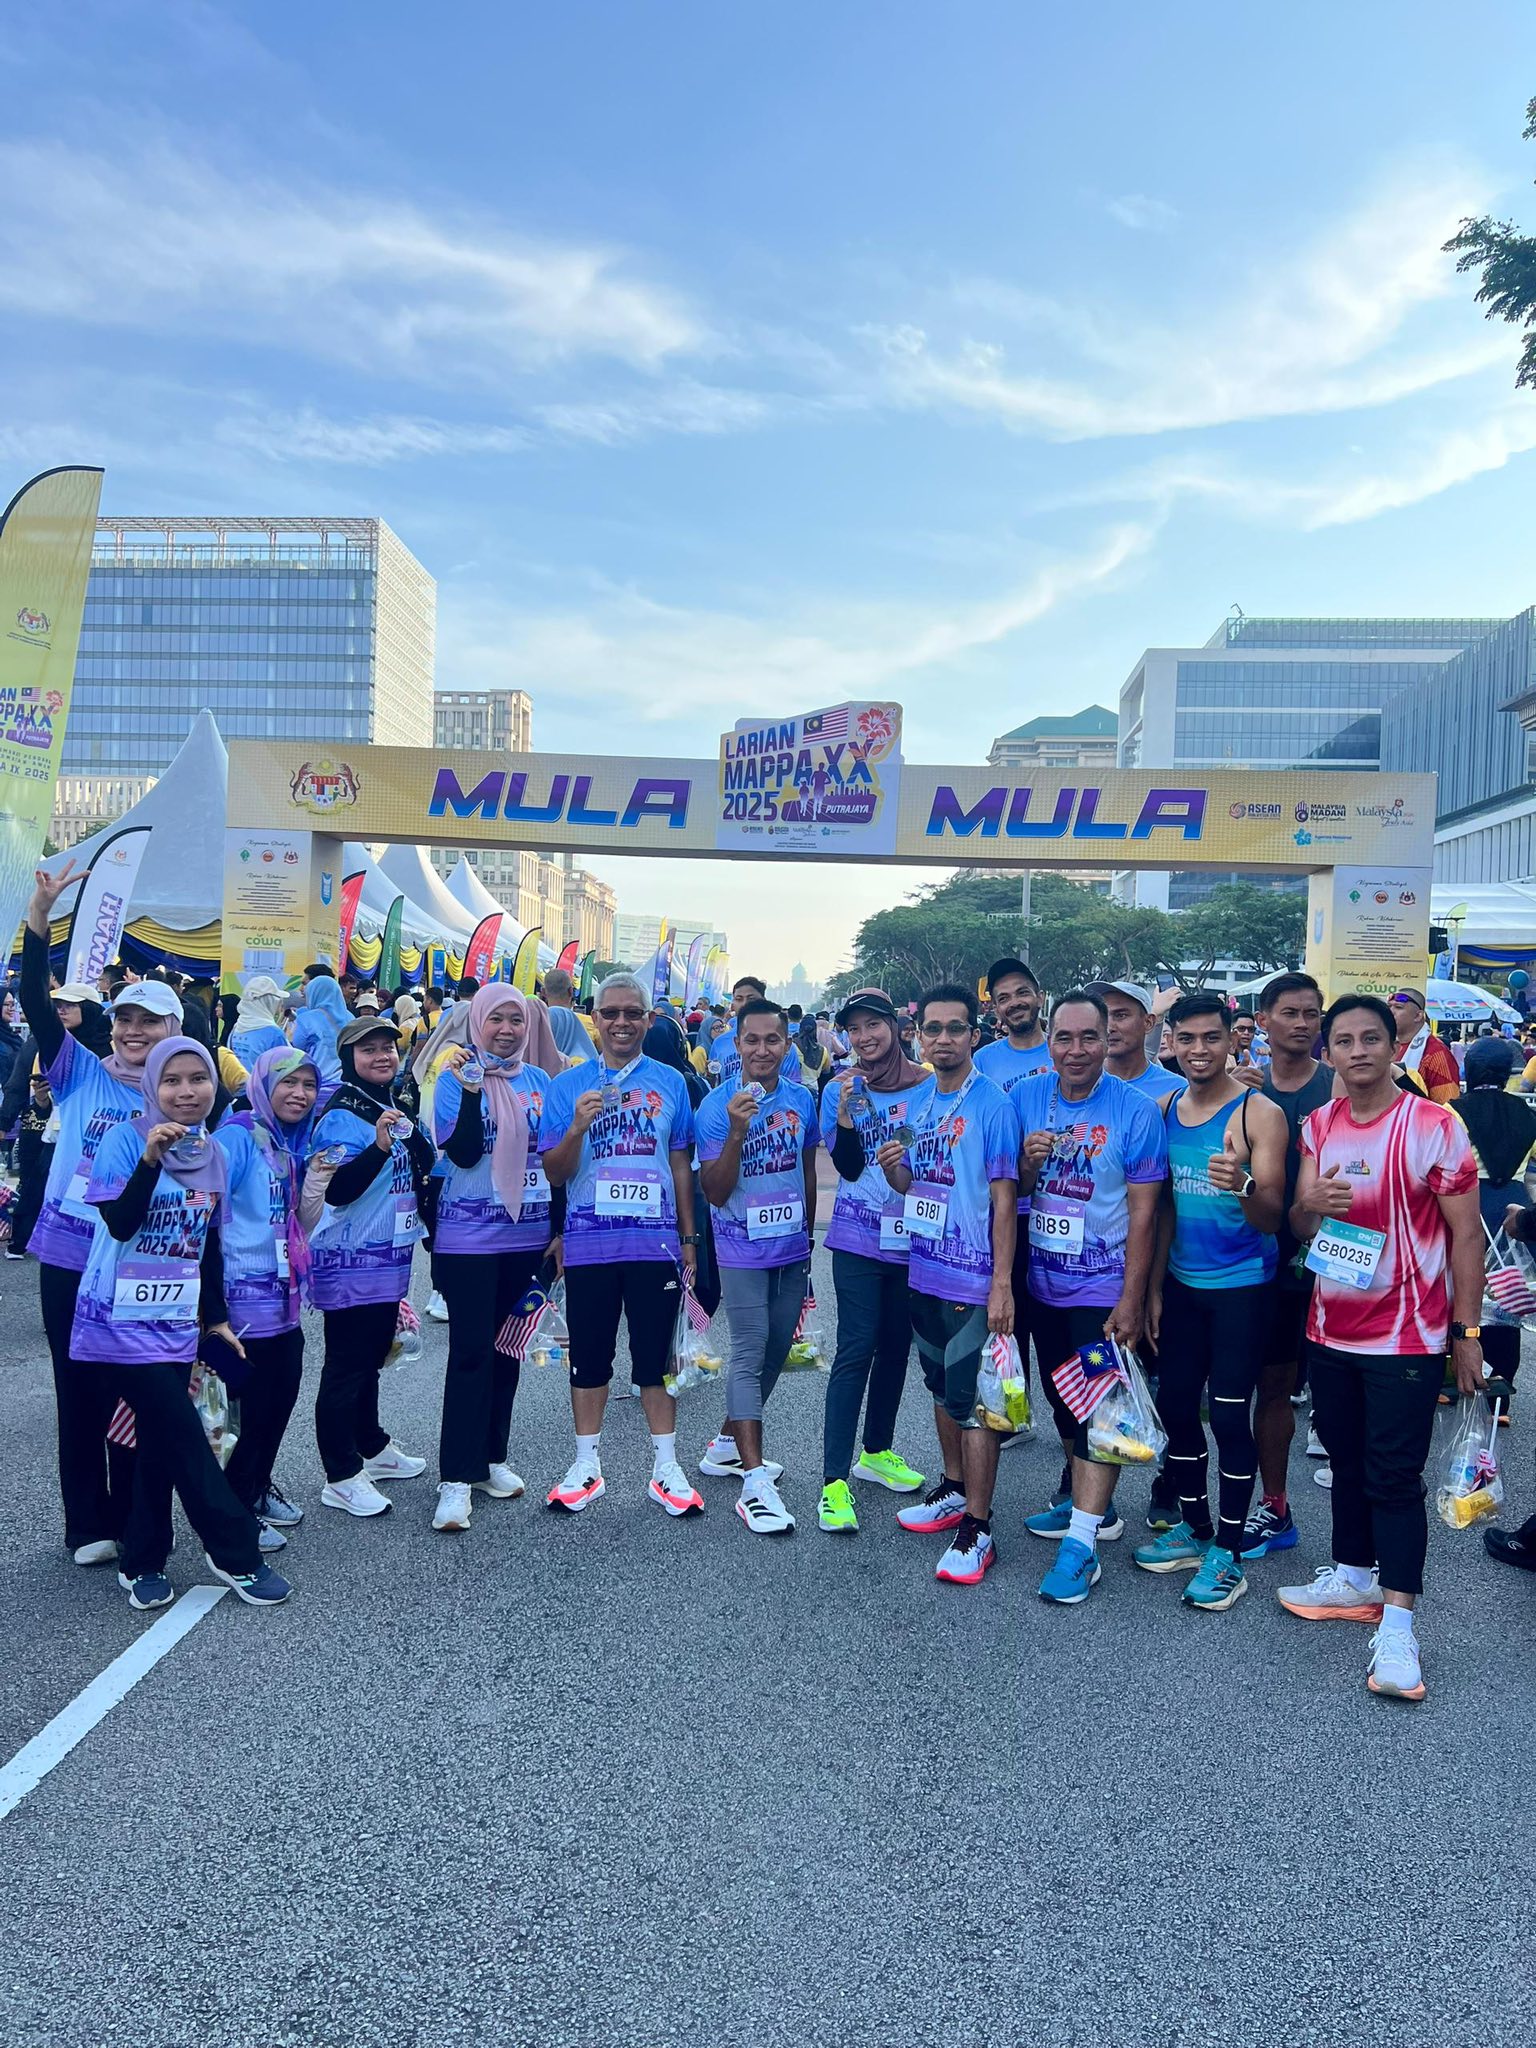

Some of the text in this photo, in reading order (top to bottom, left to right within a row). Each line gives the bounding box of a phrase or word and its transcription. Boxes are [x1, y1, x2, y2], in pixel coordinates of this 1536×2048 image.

[0, 687, 17, 701] AN
[725, 721, 796, 760] LARIAN
[24, 767, 49, 781] 2025
[724, 740, 874, 791] MAPPA XX
[428, 767, 693, 829] MULA
[723, 790, 781, 821] 2025
[1310, 803, 1346, 811] MALAYSIA
[825, 803, 869, 814] PUTRAJAYA
[925, 785, 1209, 840] MULA
[1248, 803, 1281, 814] ASEAN
[1310, 809, 1346, 817] MADANI
[743, 1122, 766, 1144] ARIAN
[742, 1158, 765, 1178] 2025
[609, 1184, 649, 1201] 6178
[1173, 1178, 1220, 1197] RATHON
[149, 1191, 183, 1211] ARIAN
[916, 1200, 940, 1222] 6181
[759, 1205, 793, 1224] 6170
[1035, 1214, 1070, 1236] 6189
[135, 1234, 171, 1256] 2025
[283, 1243, 288, 1259] 6
[1317, 1239, 1373, 1267] GB0235
[135, 1283, 184, 1302] 6177
